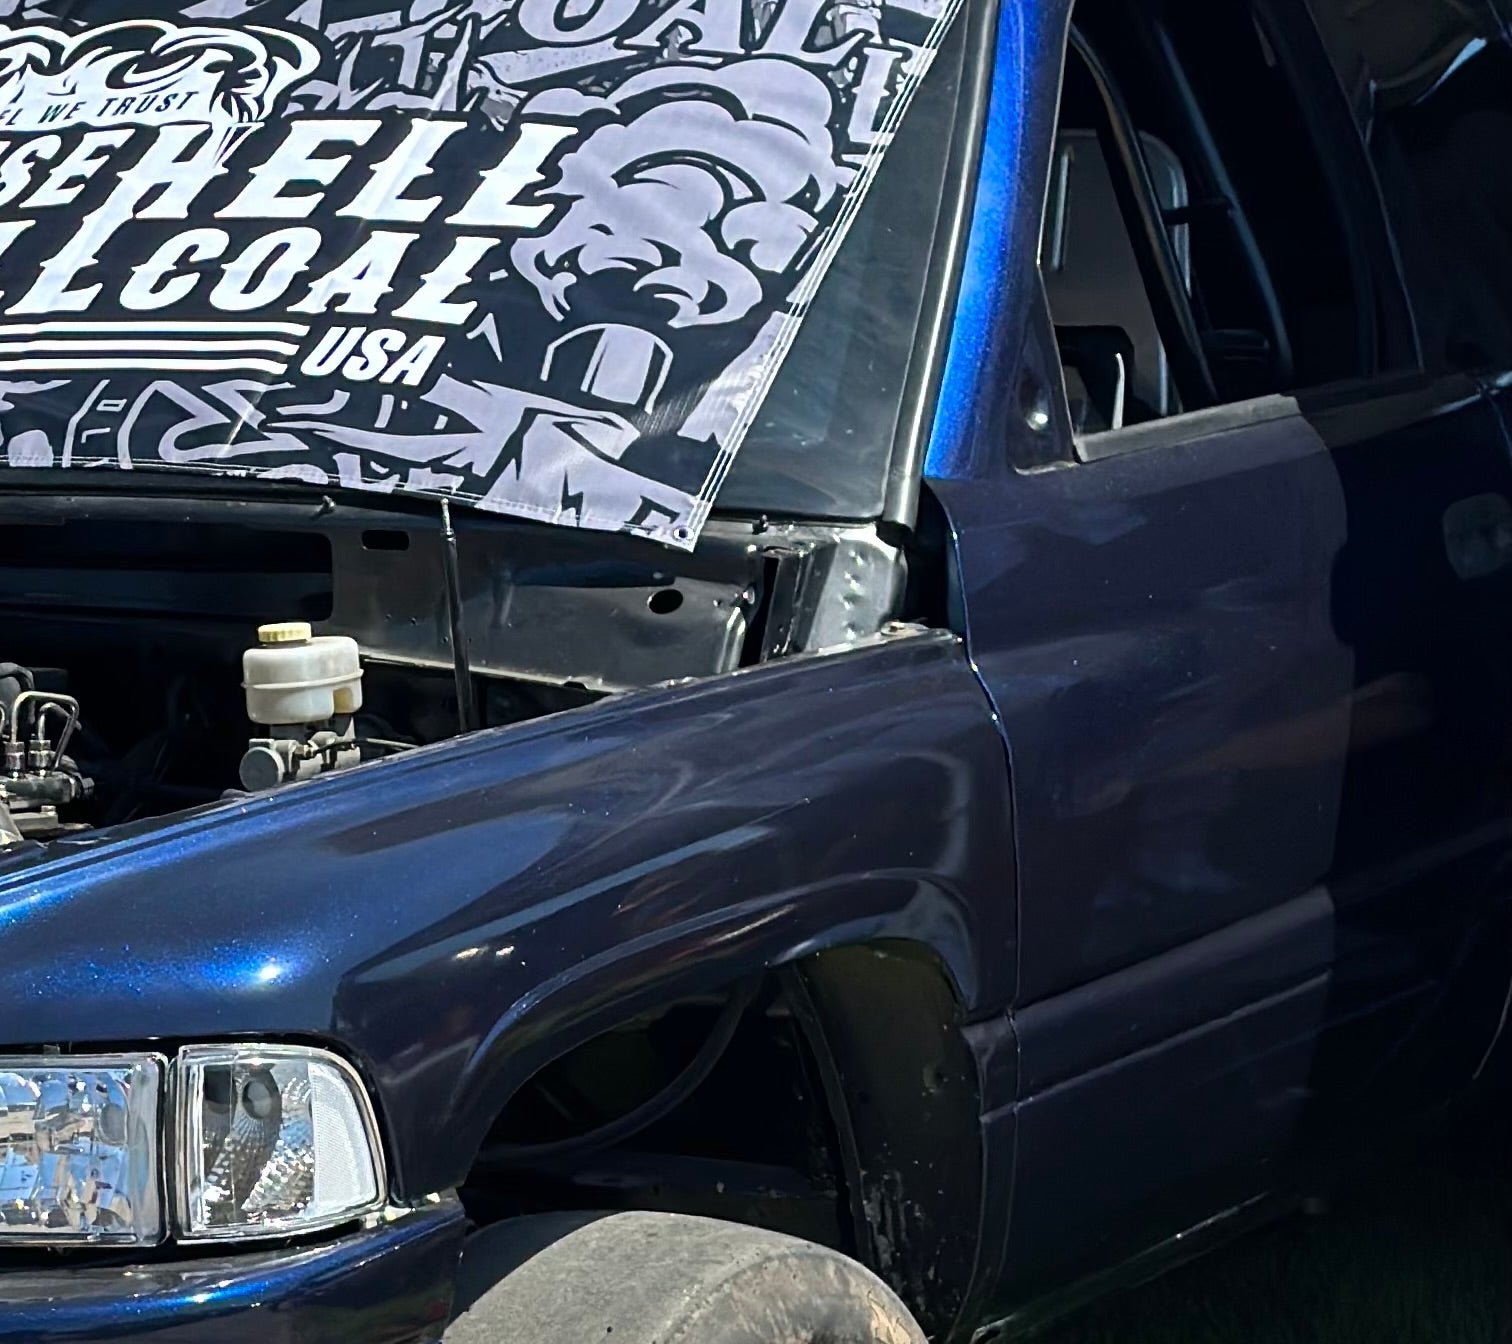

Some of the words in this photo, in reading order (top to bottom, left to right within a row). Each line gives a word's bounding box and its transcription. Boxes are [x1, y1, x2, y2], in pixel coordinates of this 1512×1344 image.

[37, 101, 84, 125] WE
[97, 90, 200, 117] TRUST
[86, 117, 579, 228] HELL
[118, 226, 501, 325] COAL
[300, 325, 446, 387] USA
